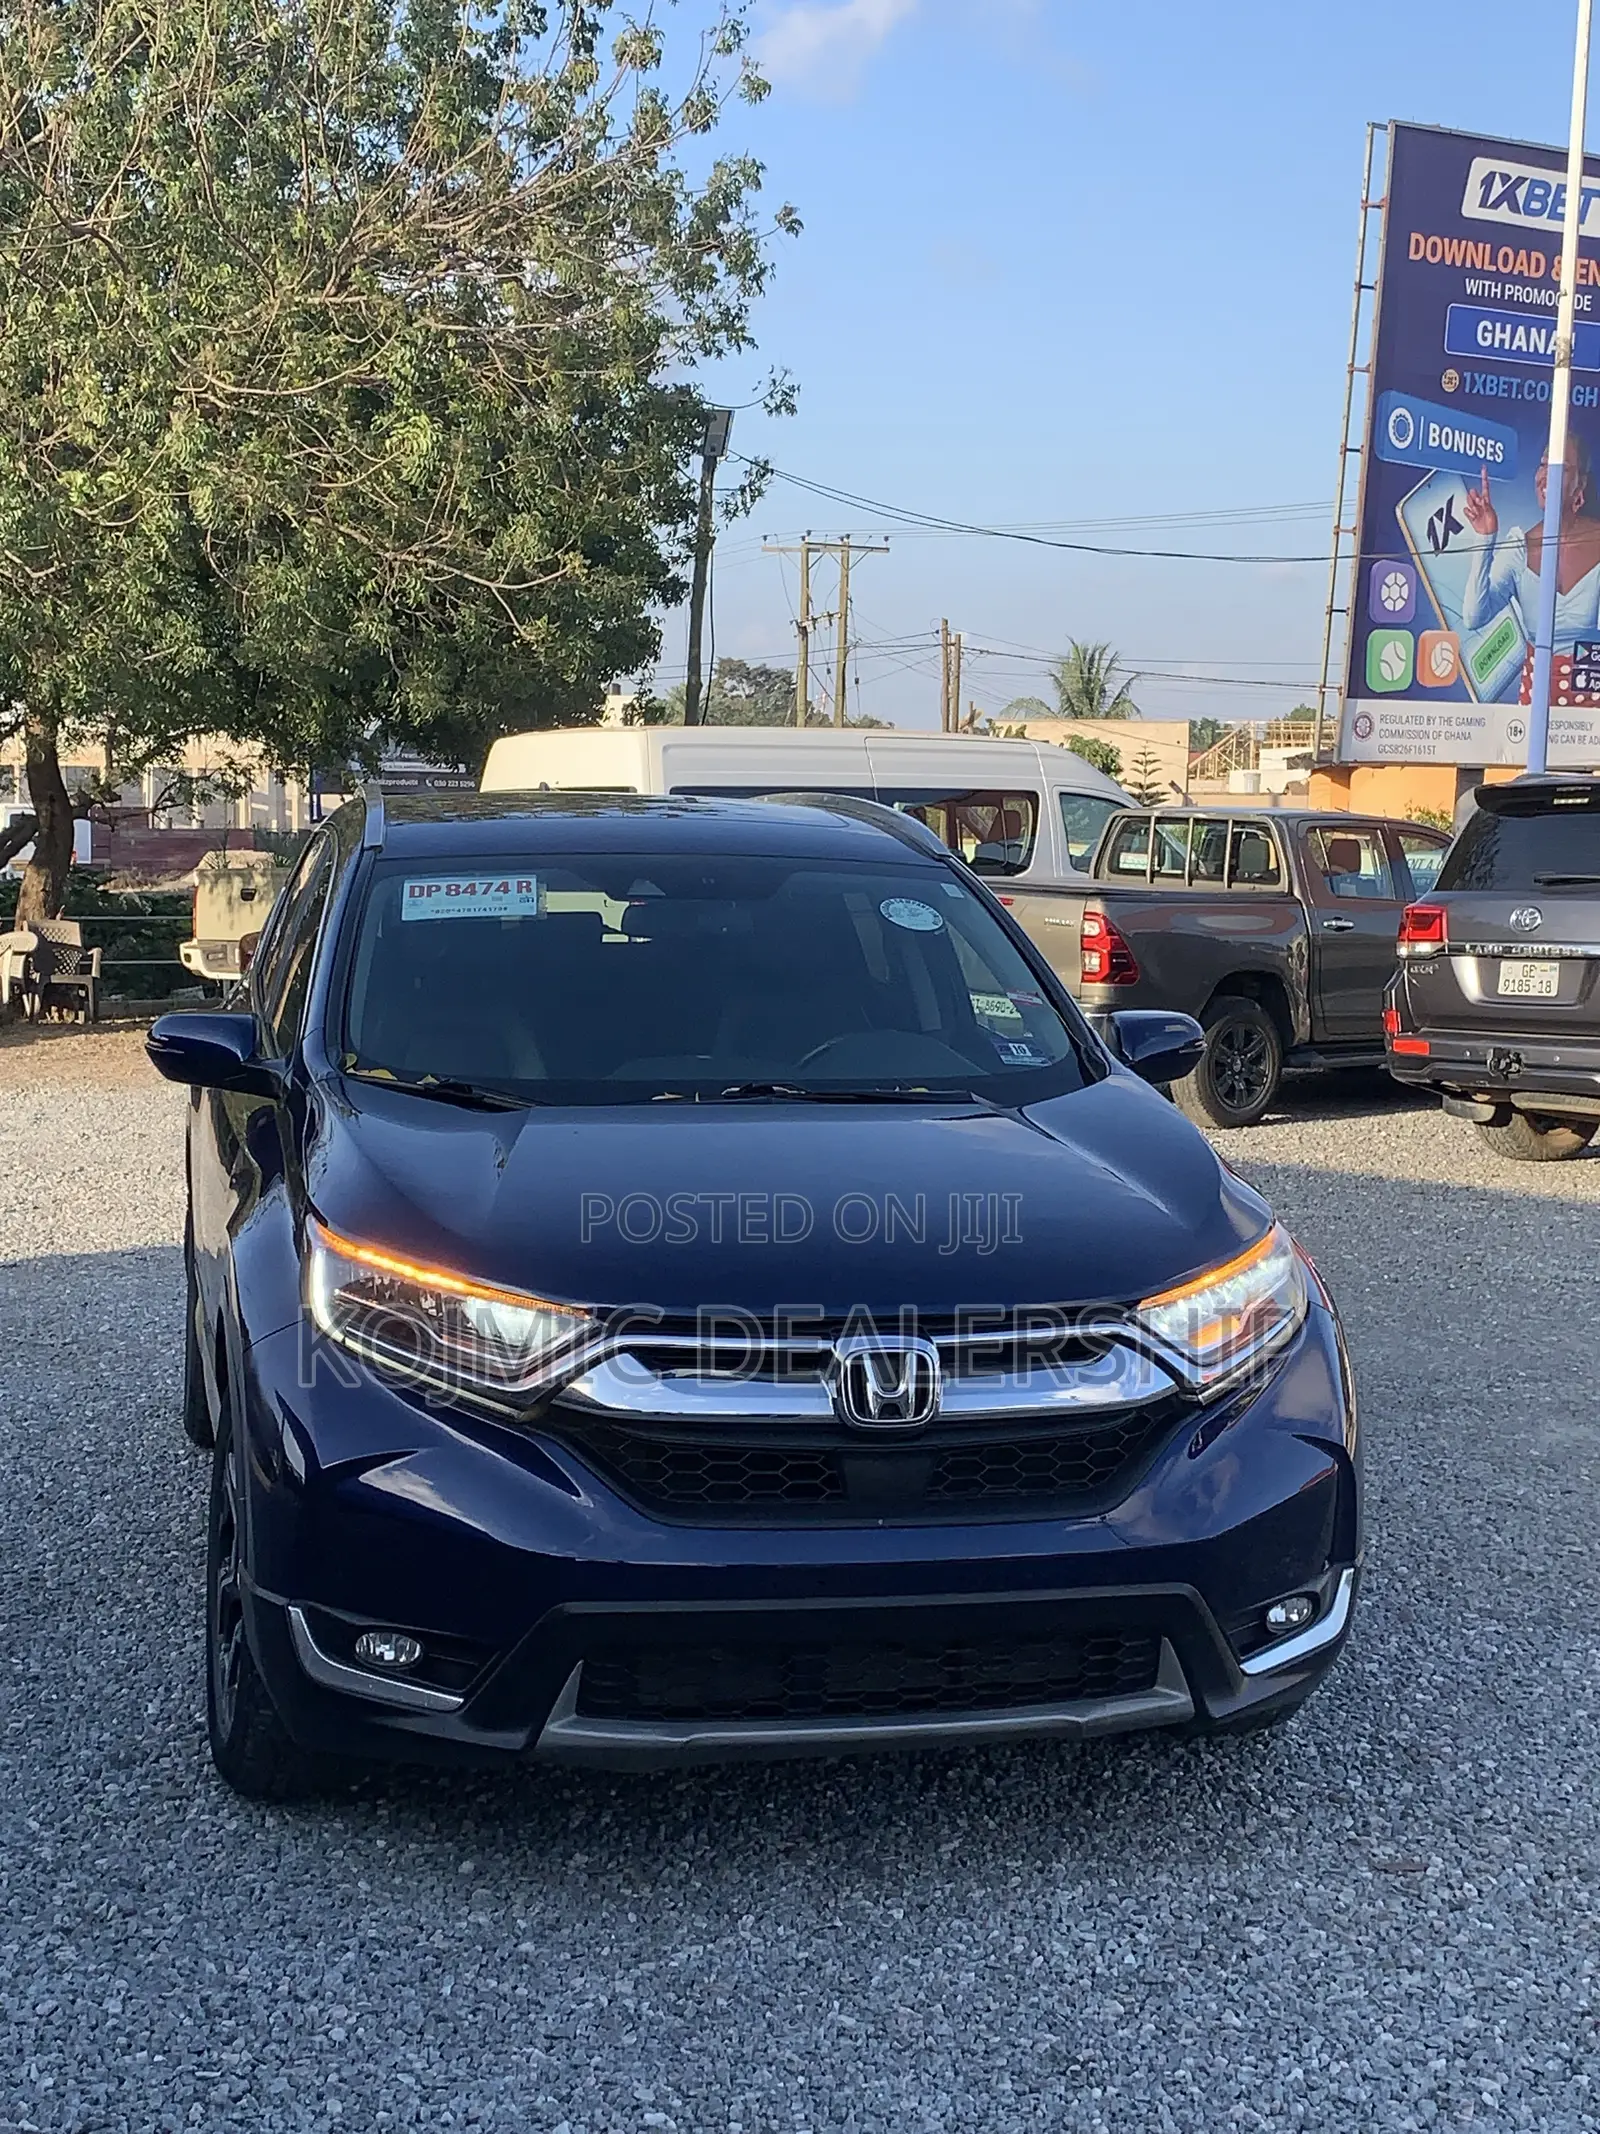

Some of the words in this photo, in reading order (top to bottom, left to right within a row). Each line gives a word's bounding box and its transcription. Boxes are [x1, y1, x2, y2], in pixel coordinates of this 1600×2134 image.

[1478, 169, 1600, 226] 1XBET
[1408, 232, 1546, 279] DOWNLOAD
[1465, 278, 1502, 299] WITH
[1428, 422, 1504, 463] BONUSES
[1478, 631, 1510, 671] DOWNLOAD
[1379, 713, 1425, 726] REGULATED
[1426, 716, 1437, 726] BY
[1438, 716, 1453, 727] THE
[1455, 716, 1486, 728] GAMING
[1378, 728, 1430, 741] COMMISSION
[1432, 730, 1441, 740] OF
[1444, 730, 1472, 741] GHANA
[1508, 726, 1523, 737] 18+
[1560, 734, 1576, 744] CAN
[1577, 735, 1587, 745] BE
[408, 884, 441, 898] DP
[445, 880, 511, 897] 8474
[516, 879, 532, 894] R
[1522, 964, 1537, 978] GE
[1503, 979, 1552, 994] 9185-18
[1012, 1044, 1027, 1055] 10
